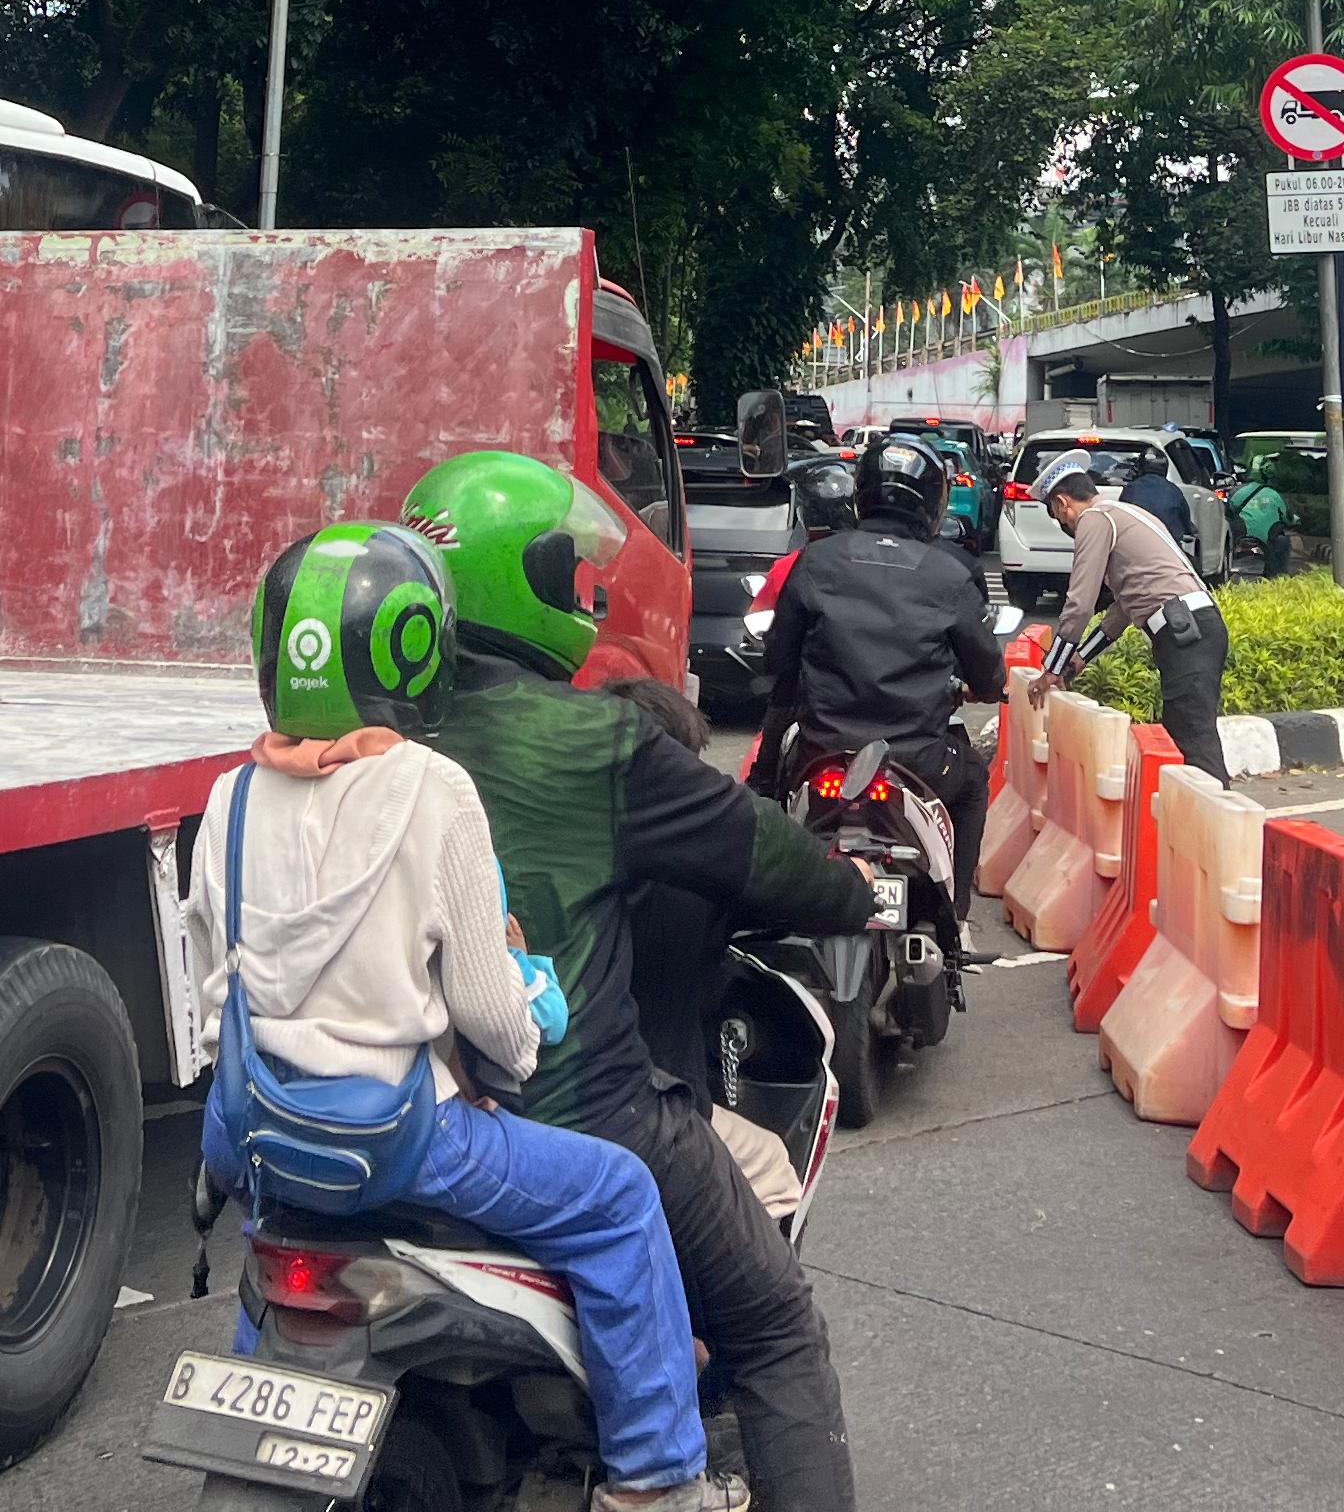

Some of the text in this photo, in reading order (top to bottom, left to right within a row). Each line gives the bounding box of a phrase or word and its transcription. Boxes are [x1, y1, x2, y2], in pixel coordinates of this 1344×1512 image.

[1275, 177, 1301, 191] Pukul
[1283, 199, 1300, 212] JBB
[1304, 197, 1334, 211] diatas
[1303, 213, 1339, 228] Kecuali
[1274, 231, 1294, 245] Hari
[1298, 230, 1323, 244] Libur
[290, 676, 329, 690] gojek
[171, 1362, 374, 1436] B 4286 FEP
